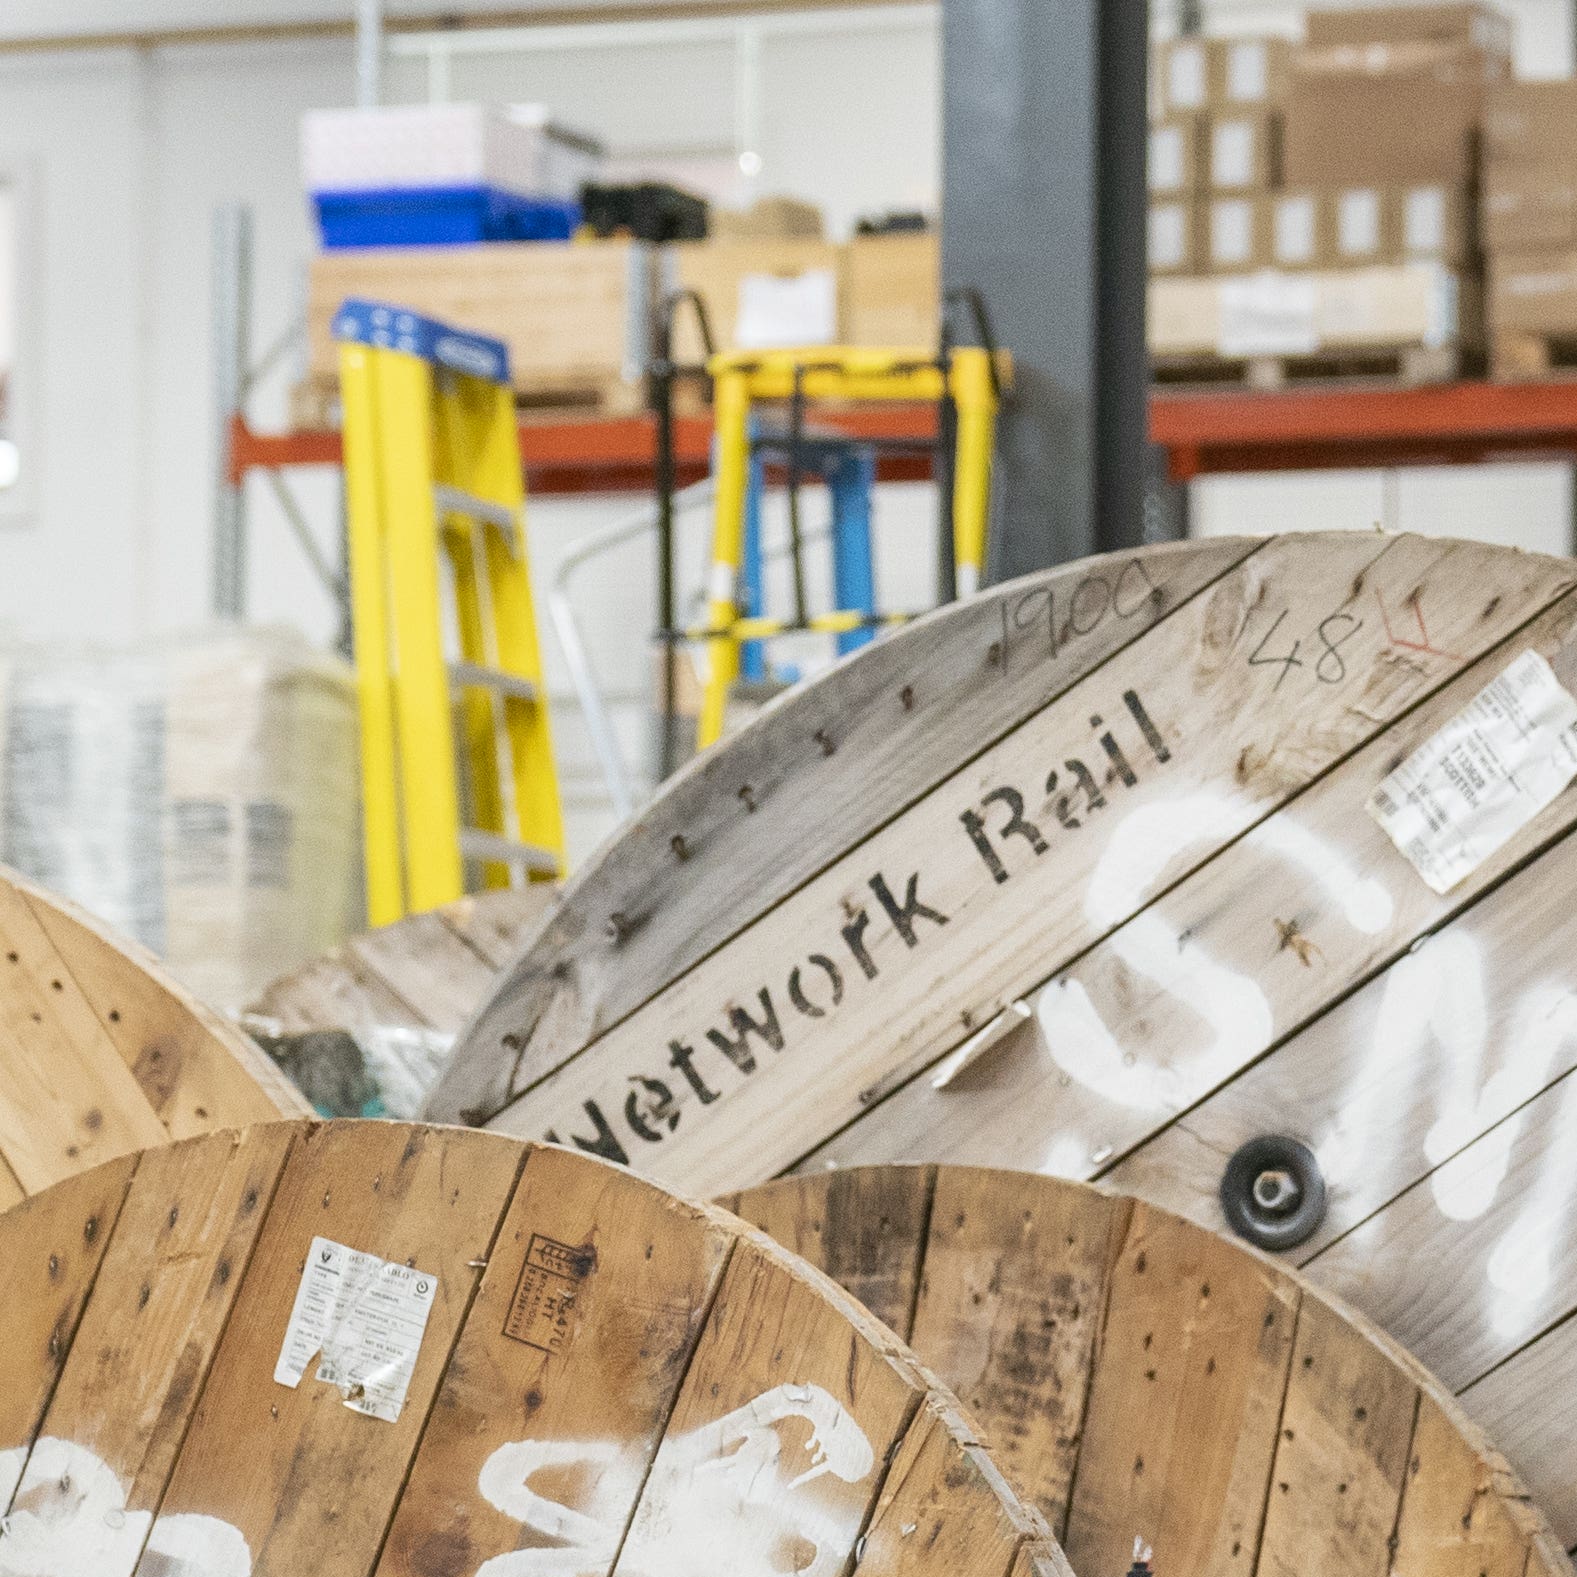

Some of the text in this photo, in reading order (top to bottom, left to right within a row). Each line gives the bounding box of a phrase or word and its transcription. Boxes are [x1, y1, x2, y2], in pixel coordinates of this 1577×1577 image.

[1247, 608, 1364, 692] 48
[547, 690, 1173, 1167] Network Rail
